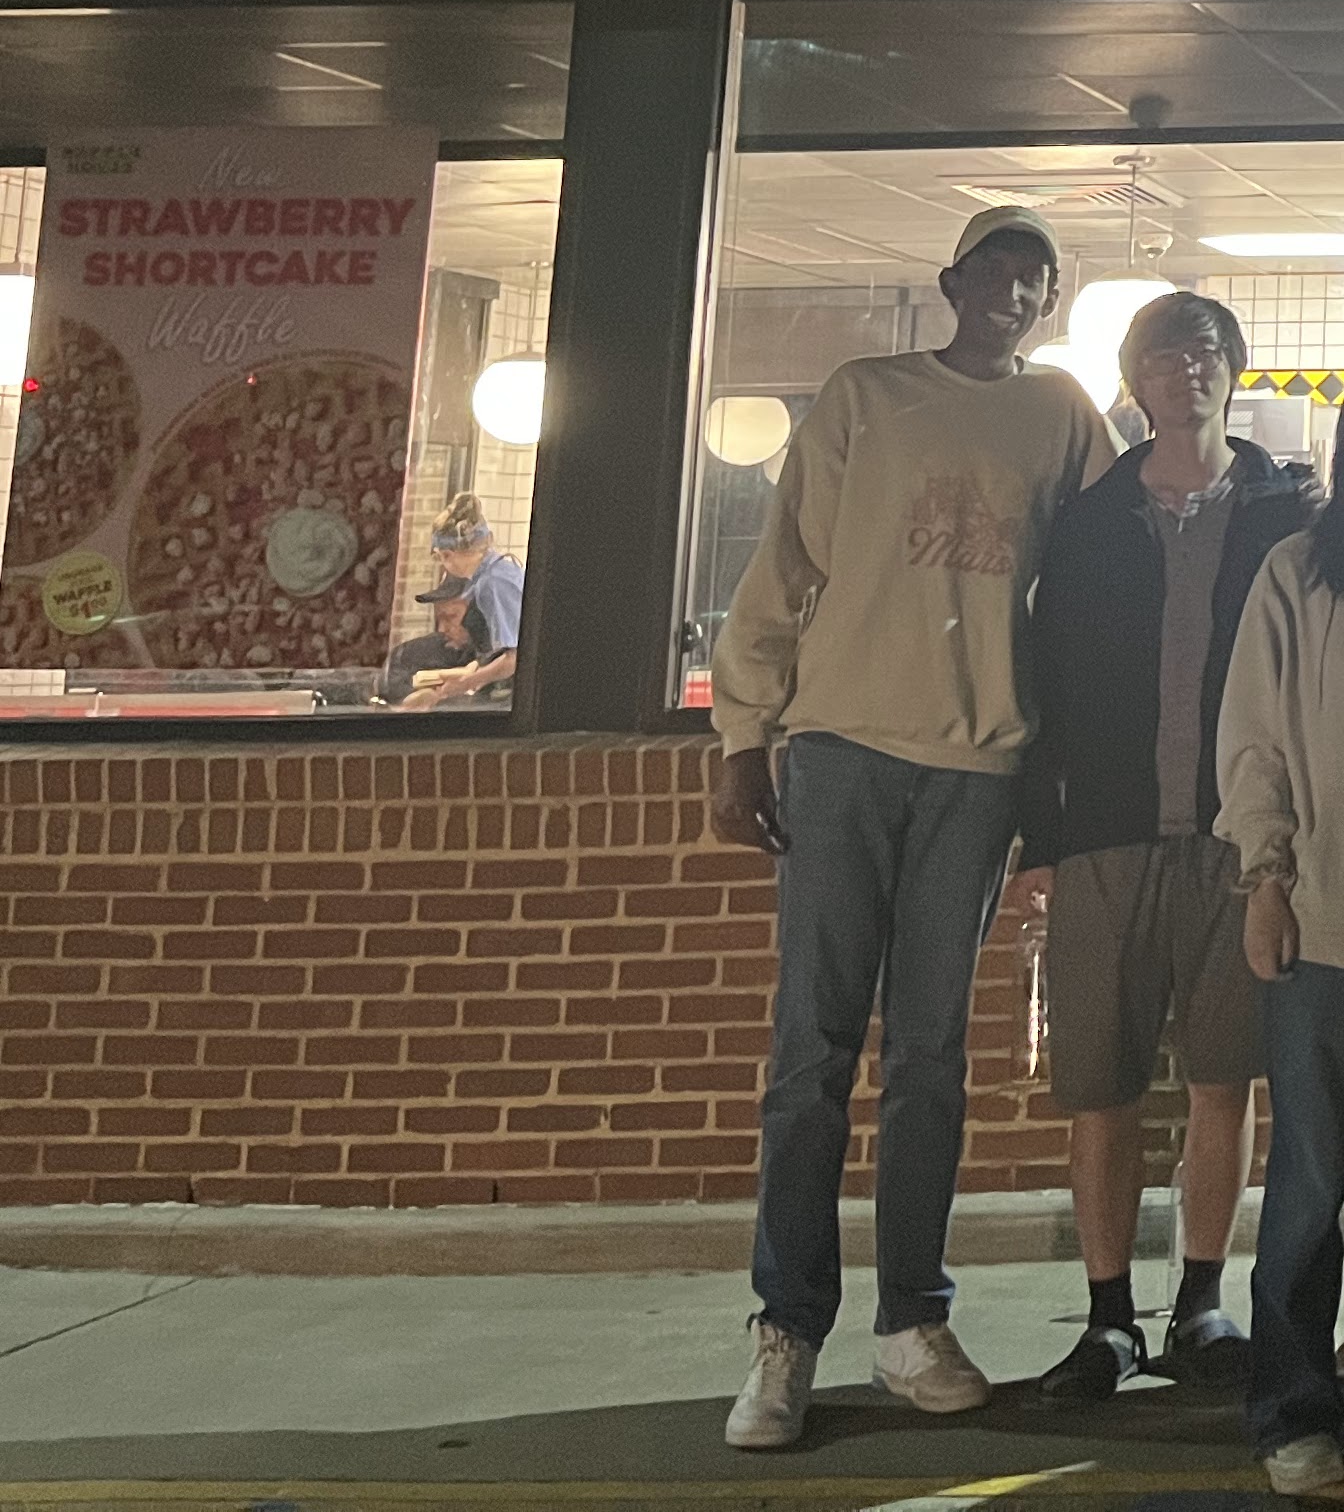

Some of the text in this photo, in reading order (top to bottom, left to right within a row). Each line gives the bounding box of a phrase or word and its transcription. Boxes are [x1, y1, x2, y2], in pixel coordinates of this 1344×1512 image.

[203, 145, 282, 188] New
[58, 197, 416, 238] STRAWBERRY
[83, 250, 378, 287] SHORTCAKE
[146, 294, 298, 364] Waffle
